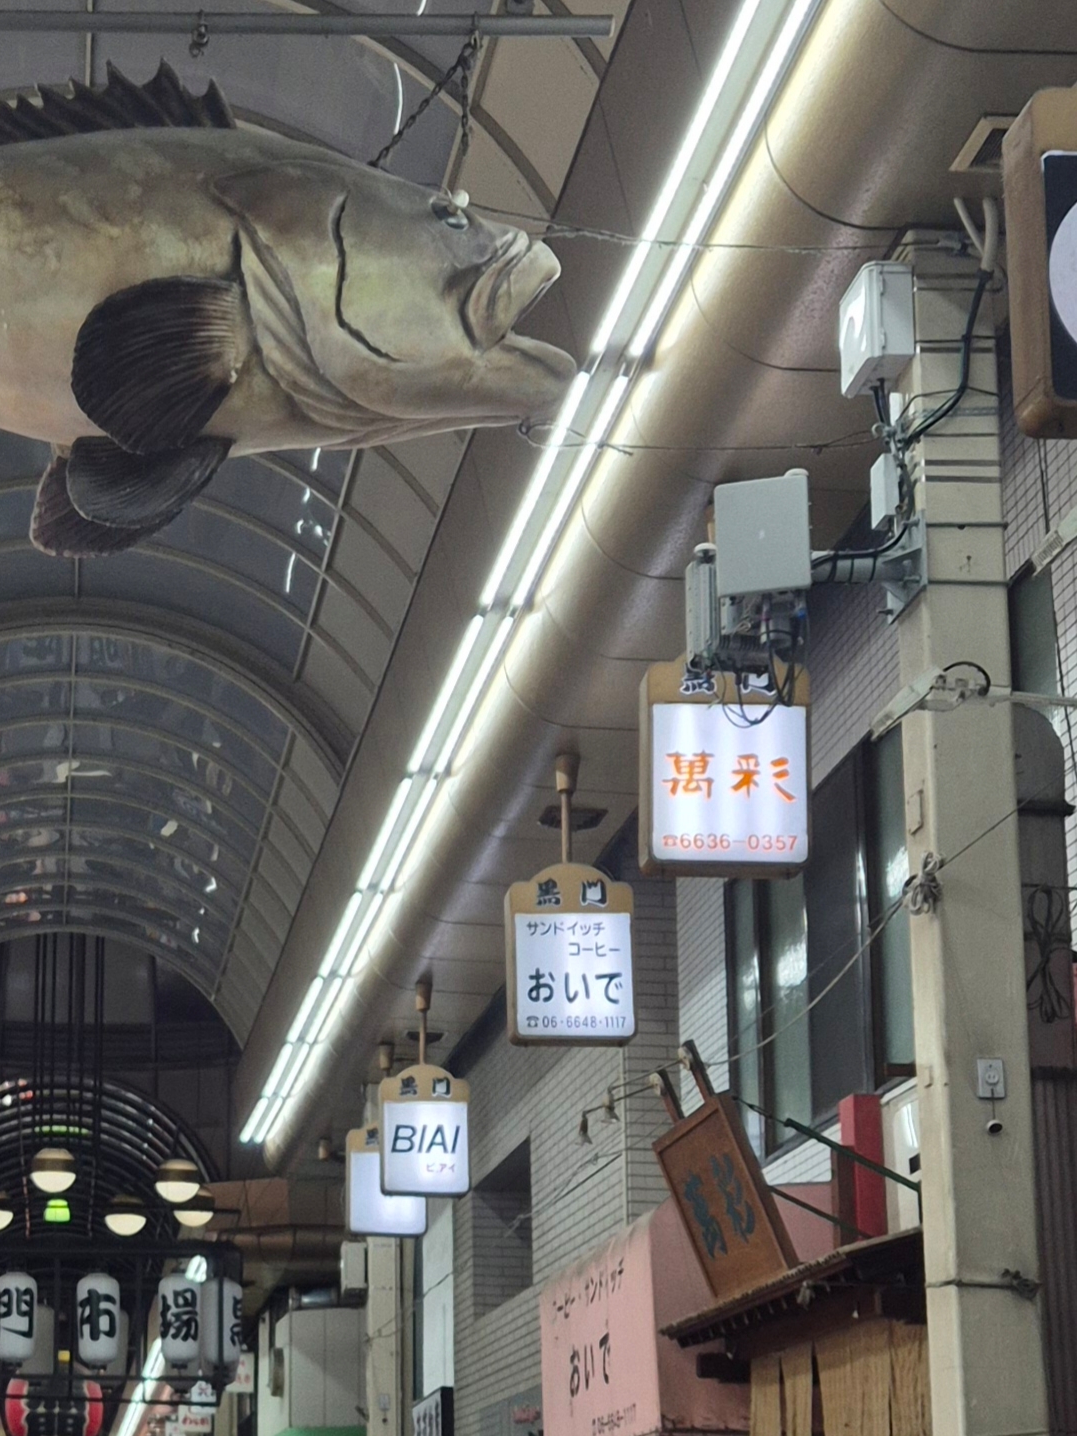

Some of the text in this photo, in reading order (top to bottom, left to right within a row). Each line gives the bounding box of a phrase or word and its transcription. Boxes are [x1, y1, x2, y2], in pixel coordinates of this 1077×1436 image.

[526, 921, 606, 936] サンドイッチ
[568, 942, 621, 957] コーヒー
[527, 968, 623, 1005] おいで
[390, 1124, 461, 1154] BIAI
[569, 1332, 611, 1398] おいで
